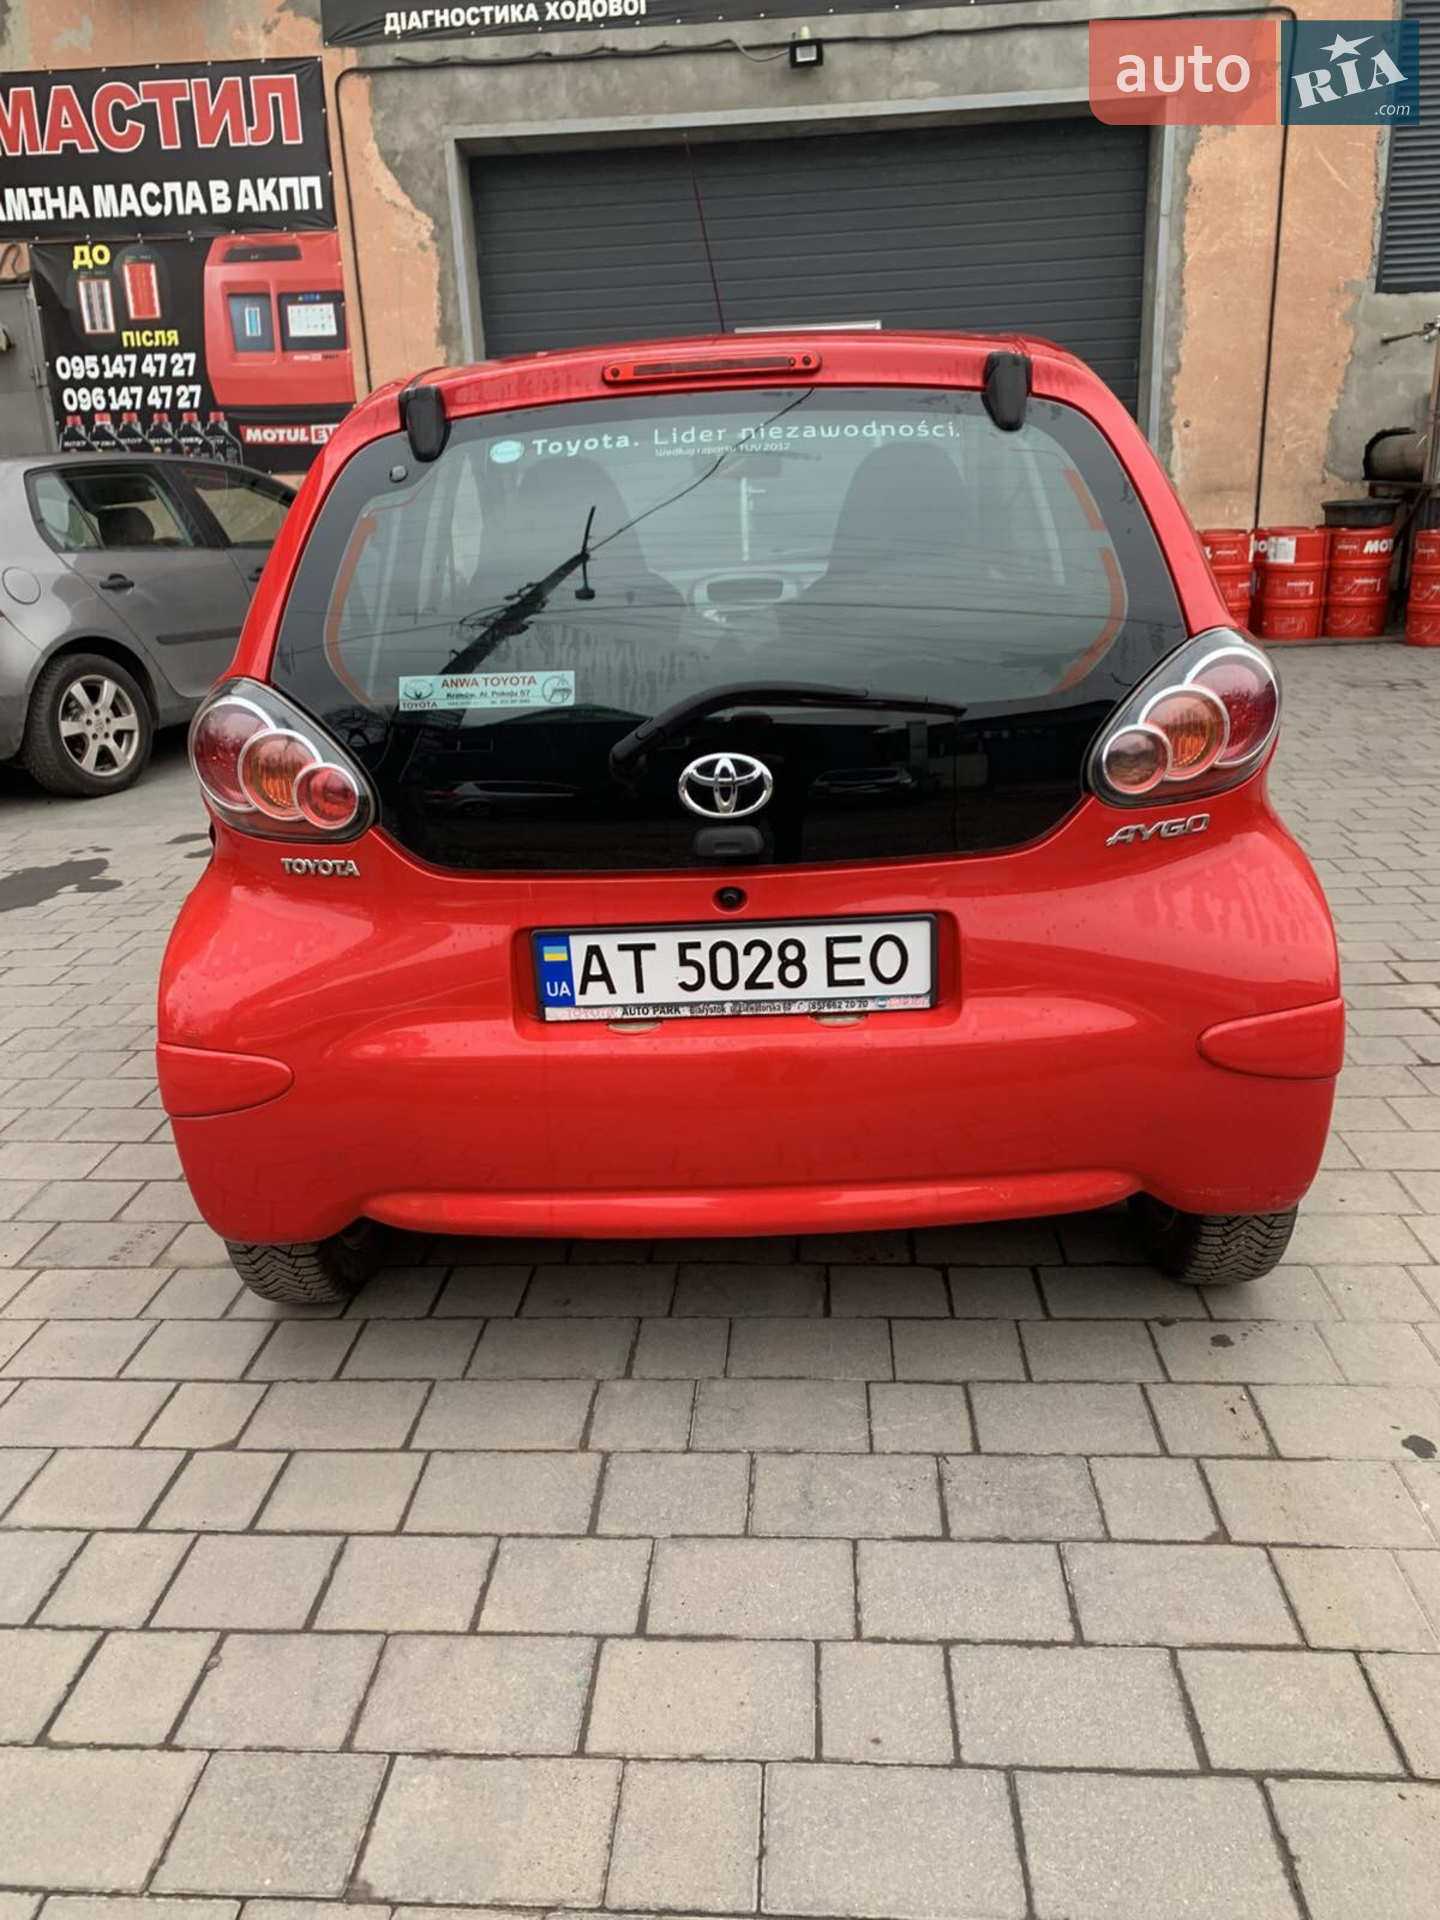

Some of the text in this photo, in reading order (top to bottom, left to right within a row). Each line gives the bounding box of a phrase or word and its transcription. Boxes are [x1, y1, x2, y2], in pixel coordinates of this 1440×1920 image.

[384, 3, 540, 35] ДІАГНОСТИКА
[0, 74, 303, 156] МАСТИЛ
[93, 180, 207, 217] МАСЛА
[208, 179, 233, 214] В
[237, 176, 323, 213] АКПП
[72, 244, 112, 270] ДО
[122, 329, 179, 347] ПІСЛЯ
[55, 352, 197, 380] 095 147 47 27
[62, 384, 202, 412] 096 147 47 27
[246, 427, 309, 443] MOTUL
[532, 434, 639, 457] Toyota.
[653, 427, 728, 445] Lider
[441, 675, 538, 689] ANWA TOYOTA
[402, 702, 438, 710] TOYOTA
[1106, 813, 1210, 846] AYGO
[280, 857, 361, 877] TOYOTA
[578, 933, 909, 996] AT 5028 EO
[546, 982, 571, 997] UA
[621, 1006, 650, 1017] AUTO
[652, 1005, 682, 1016] PARK
